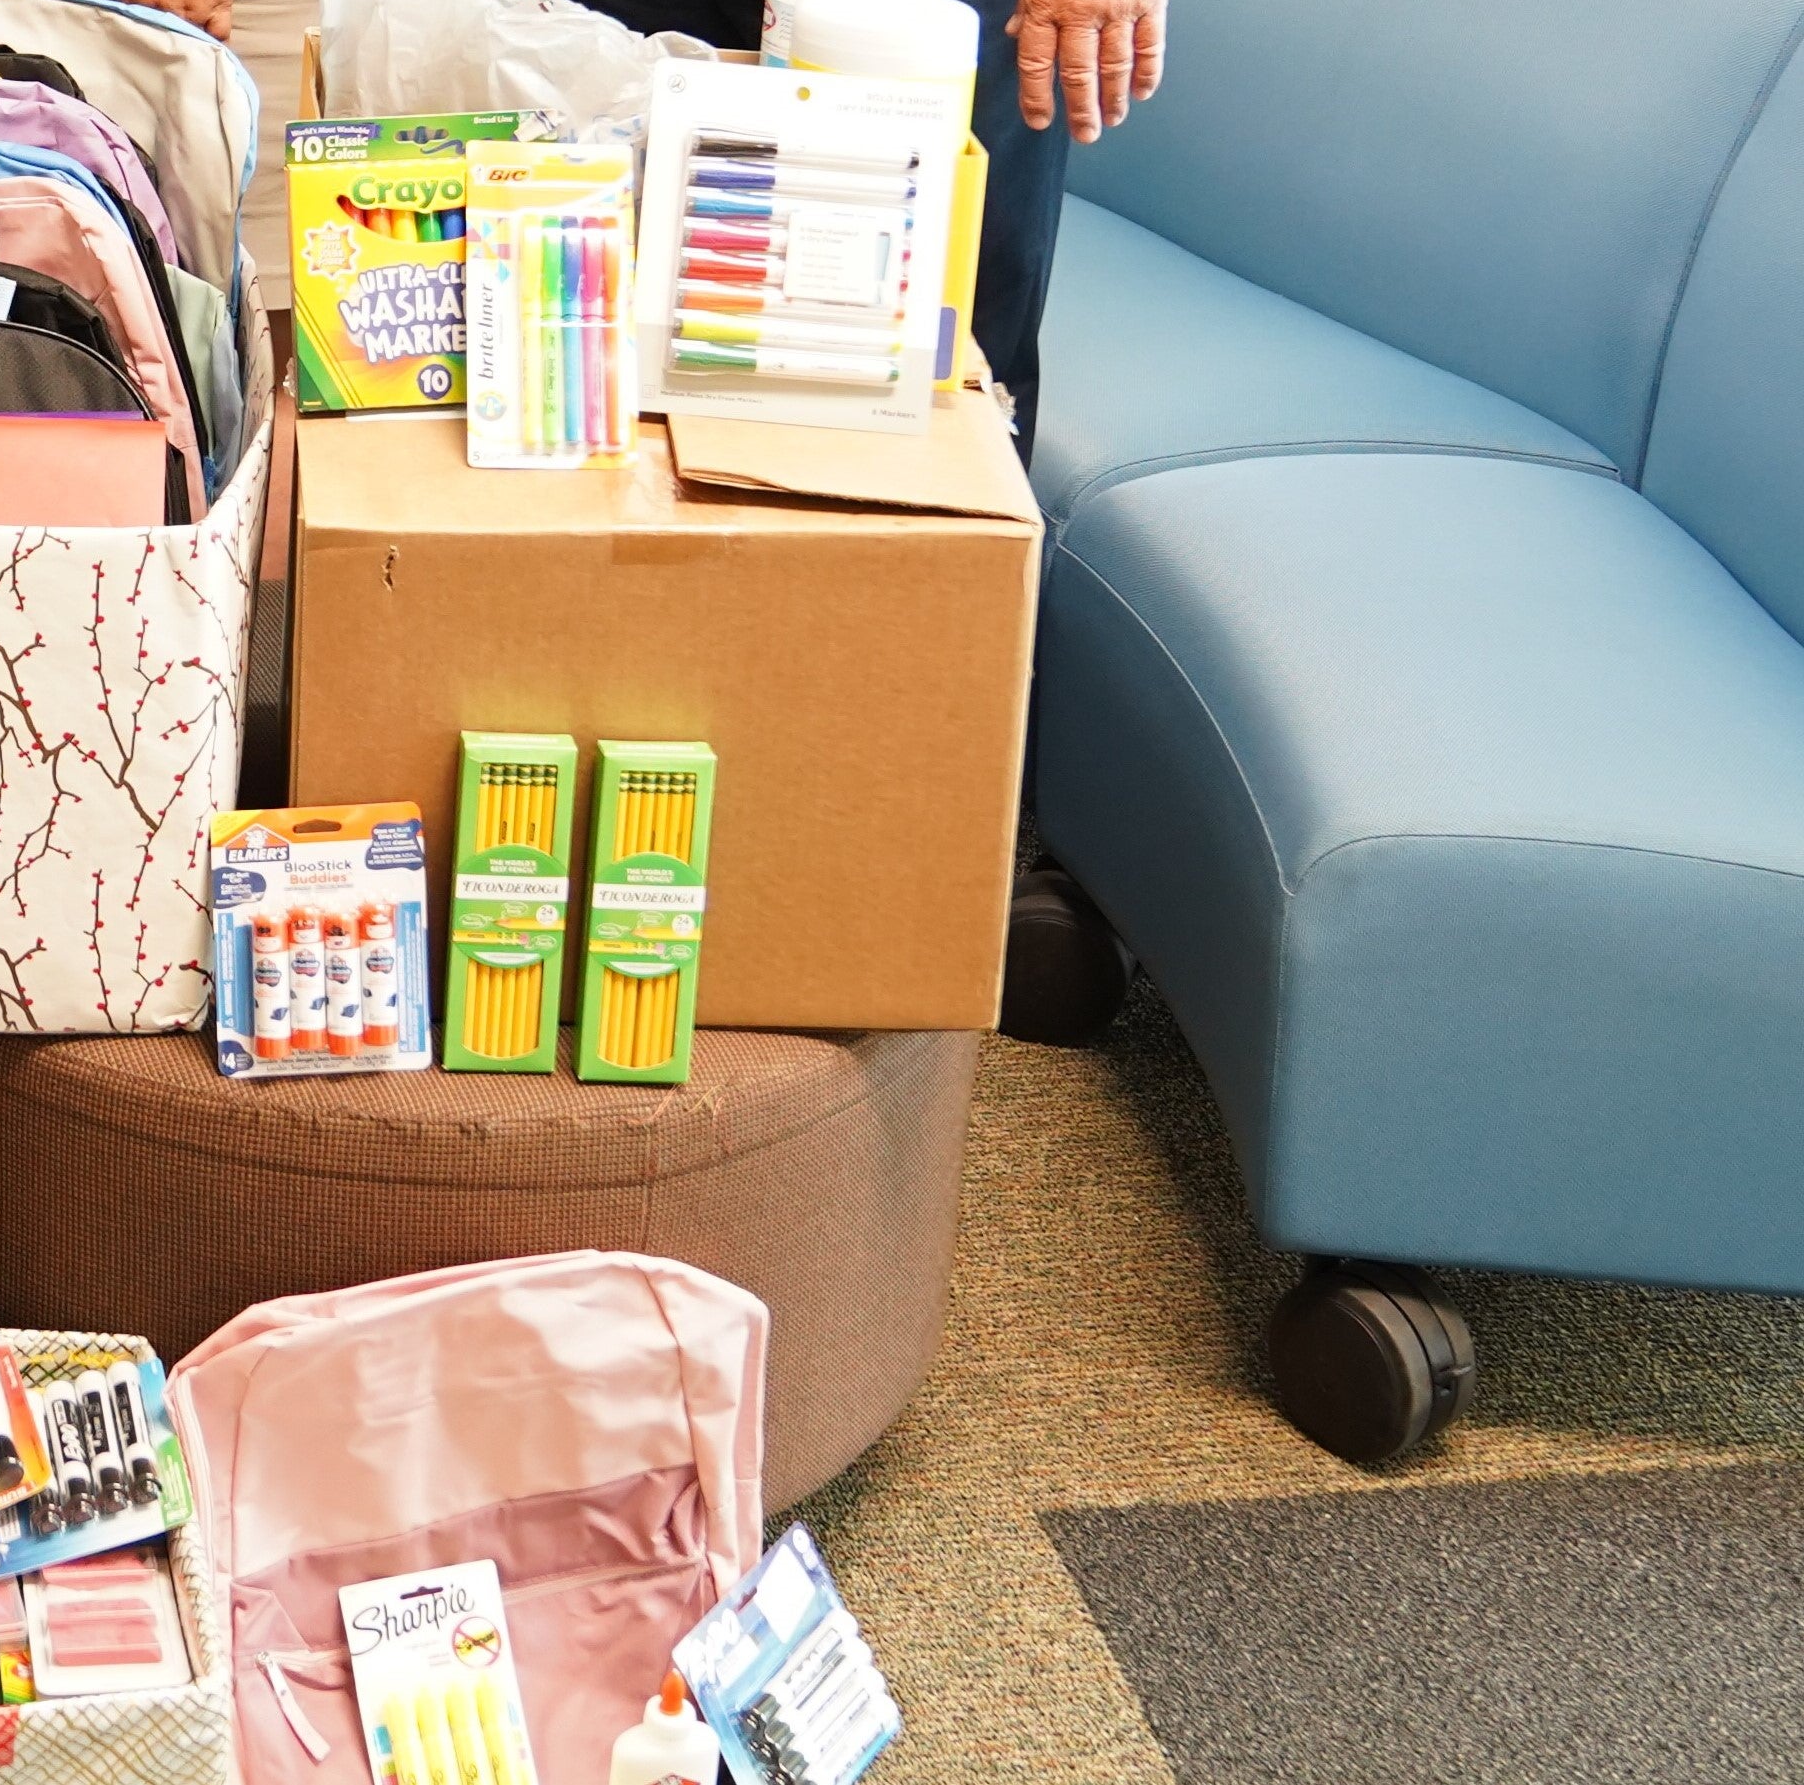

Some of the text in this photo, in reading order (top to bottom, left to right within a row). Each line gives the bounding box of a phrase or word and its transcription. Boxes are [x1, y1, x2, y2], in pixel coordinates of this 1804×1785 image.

[291, 134, 368, 163] 10 Classic
[325, 147, 368, 161] Colors
[352, 176, 464, 209] Crayo
[339, 286, 467, 333] WASHA
[419, 369, 449, 393] 10
[228, 846, 289, 863] ELMER'S
[284, 859, 352, 873] BlooStick
[290, 872, 347, 884] Buddies
[463, 880, 560, 895] TICONDEROGA
[599, 890, 695, 904] TICONDEROGA
[350, 1584, 475, 1656] Sharpie
